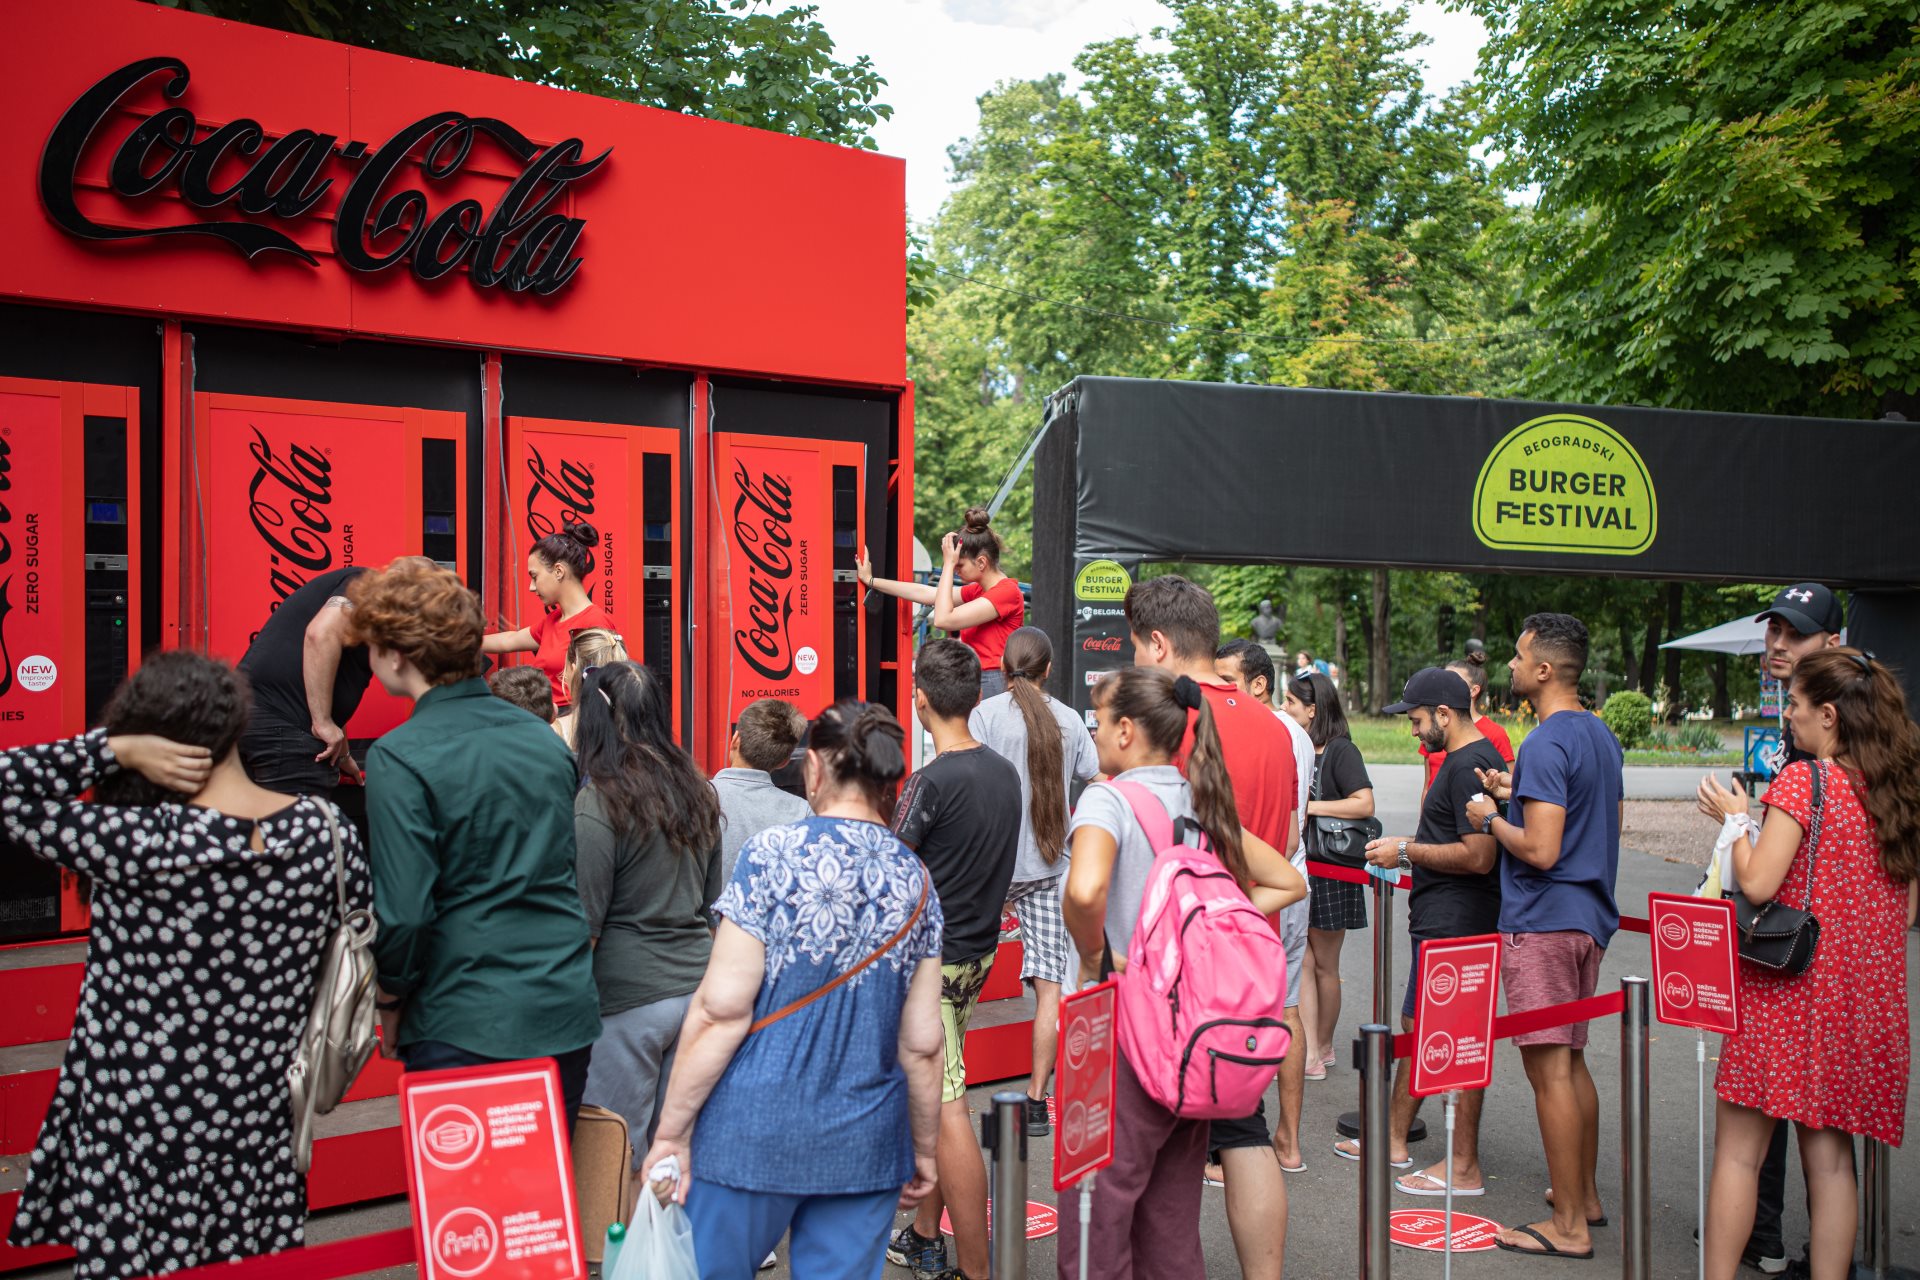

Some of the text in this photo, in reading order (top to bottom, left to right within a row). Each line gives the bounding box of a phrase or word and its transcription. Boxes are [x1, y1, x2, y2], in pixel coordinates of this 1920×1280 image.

[38, 56, 614, 296] Coca-Cola
[1523, 435, 1615, 462] BEOGRADSKI
[1509, 468, 1626, 497] BURGER
[1496, 501, 1637, 531] FESTIVAL
[26, 512, 39, 615] ZERO SUGAR
[604, 532, 614, 615] ZERO SUGAR
[734, 457, 794, 681] Coca-Cola
[799, 539, 809, 616] ZERO SUGAR
[1082, 586, 1126, 594] FESTIVAL
[1085, 575, 1123, 584] BURGER
[797, 653, 815, 661] NEW
[1082, 636, 1123, 651] Coca-Cola
[21, 665, 53, 675] NEW
[741, 688, 800, 698] NO CALORIES
